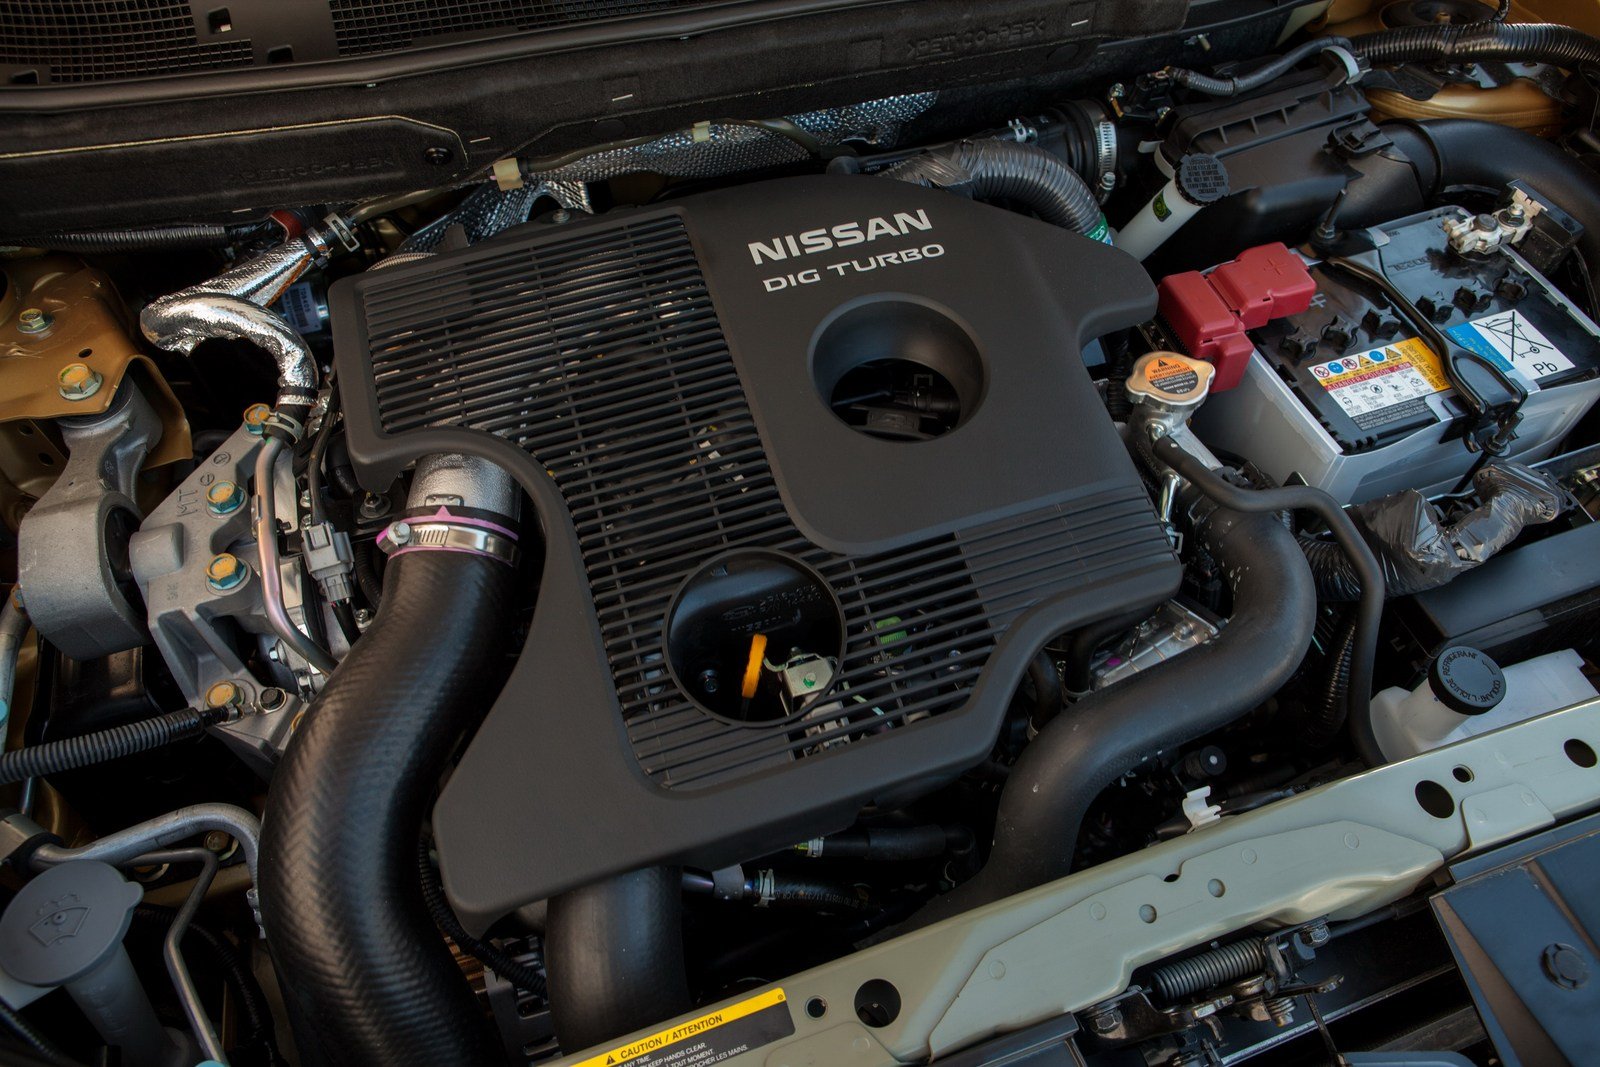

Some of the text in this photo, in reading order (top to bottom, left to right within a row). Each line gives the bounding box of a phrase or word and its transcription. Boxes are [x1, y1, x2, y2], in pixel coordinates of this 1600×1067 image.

[748, 209, 933, 266] NISSAN
[762, 243, 945, 293] DIG TURBO
[1532, 361, 1558, 376] Pb
[620, 1037, 662, 1059] CAUTION
[672, 1014, 723, 1040] ATTENTION
[648, 1058, 663, 1067] KEEP
[663, 1050, 686, 1064] HANDS
[671, 1058, 687, 1067] TOUT
[716, 1051, 728, 1061] LES
